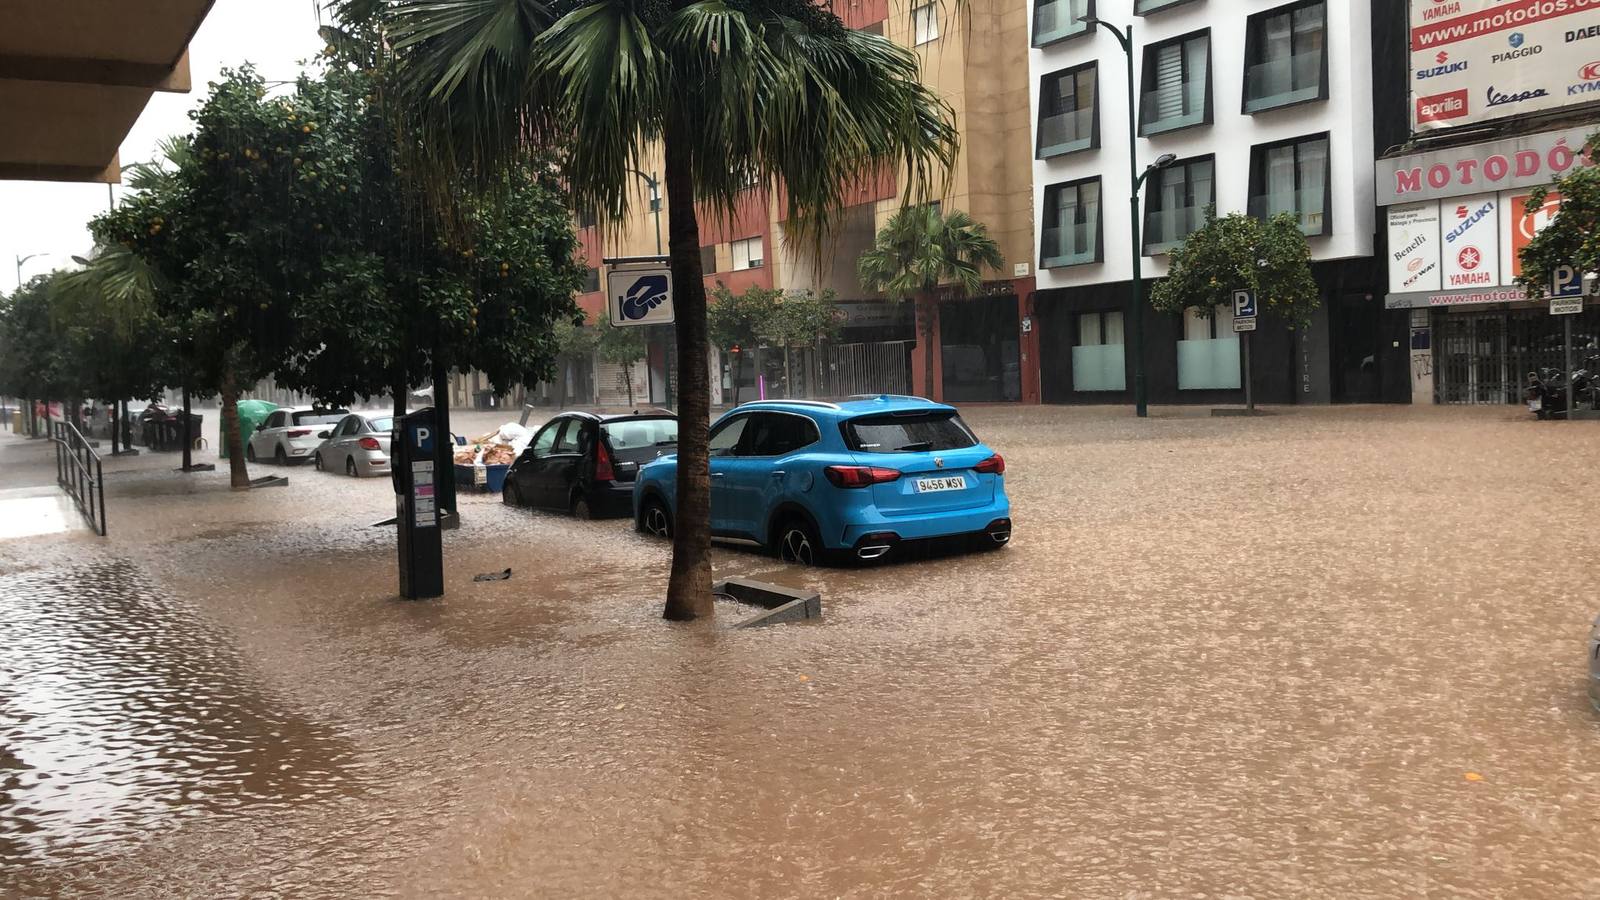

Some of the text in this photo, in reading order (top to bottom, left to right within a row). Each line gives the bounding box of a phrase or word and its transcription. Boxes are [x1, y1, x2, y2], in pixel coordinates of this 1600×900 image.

[1422, 2, 1461, 21] YAMAHA
[1419, 0, 1600, 45] www.motodos.c
[1491, 45, 1543, 64] PIAGGIO
[1416, 60, 1468, 80] SUZUKI
[1485, 85, 1549, 107] Vespa
[1421, 97, 1463, 117] aprilia
[1445, 201, 1495, 244] SUZUKI
[1393, 233, 1427, 262] Benelli
[1449, 271, 1490, 286] YAMAHA
[1553, 264, 1574, 295] P
[1235, 291, 1249, 316] P
[1429, 288, 1537, 305] www.motodo
[416, 427, 430, 448] P
[919, 477, 964, 492] 9456 MSV
